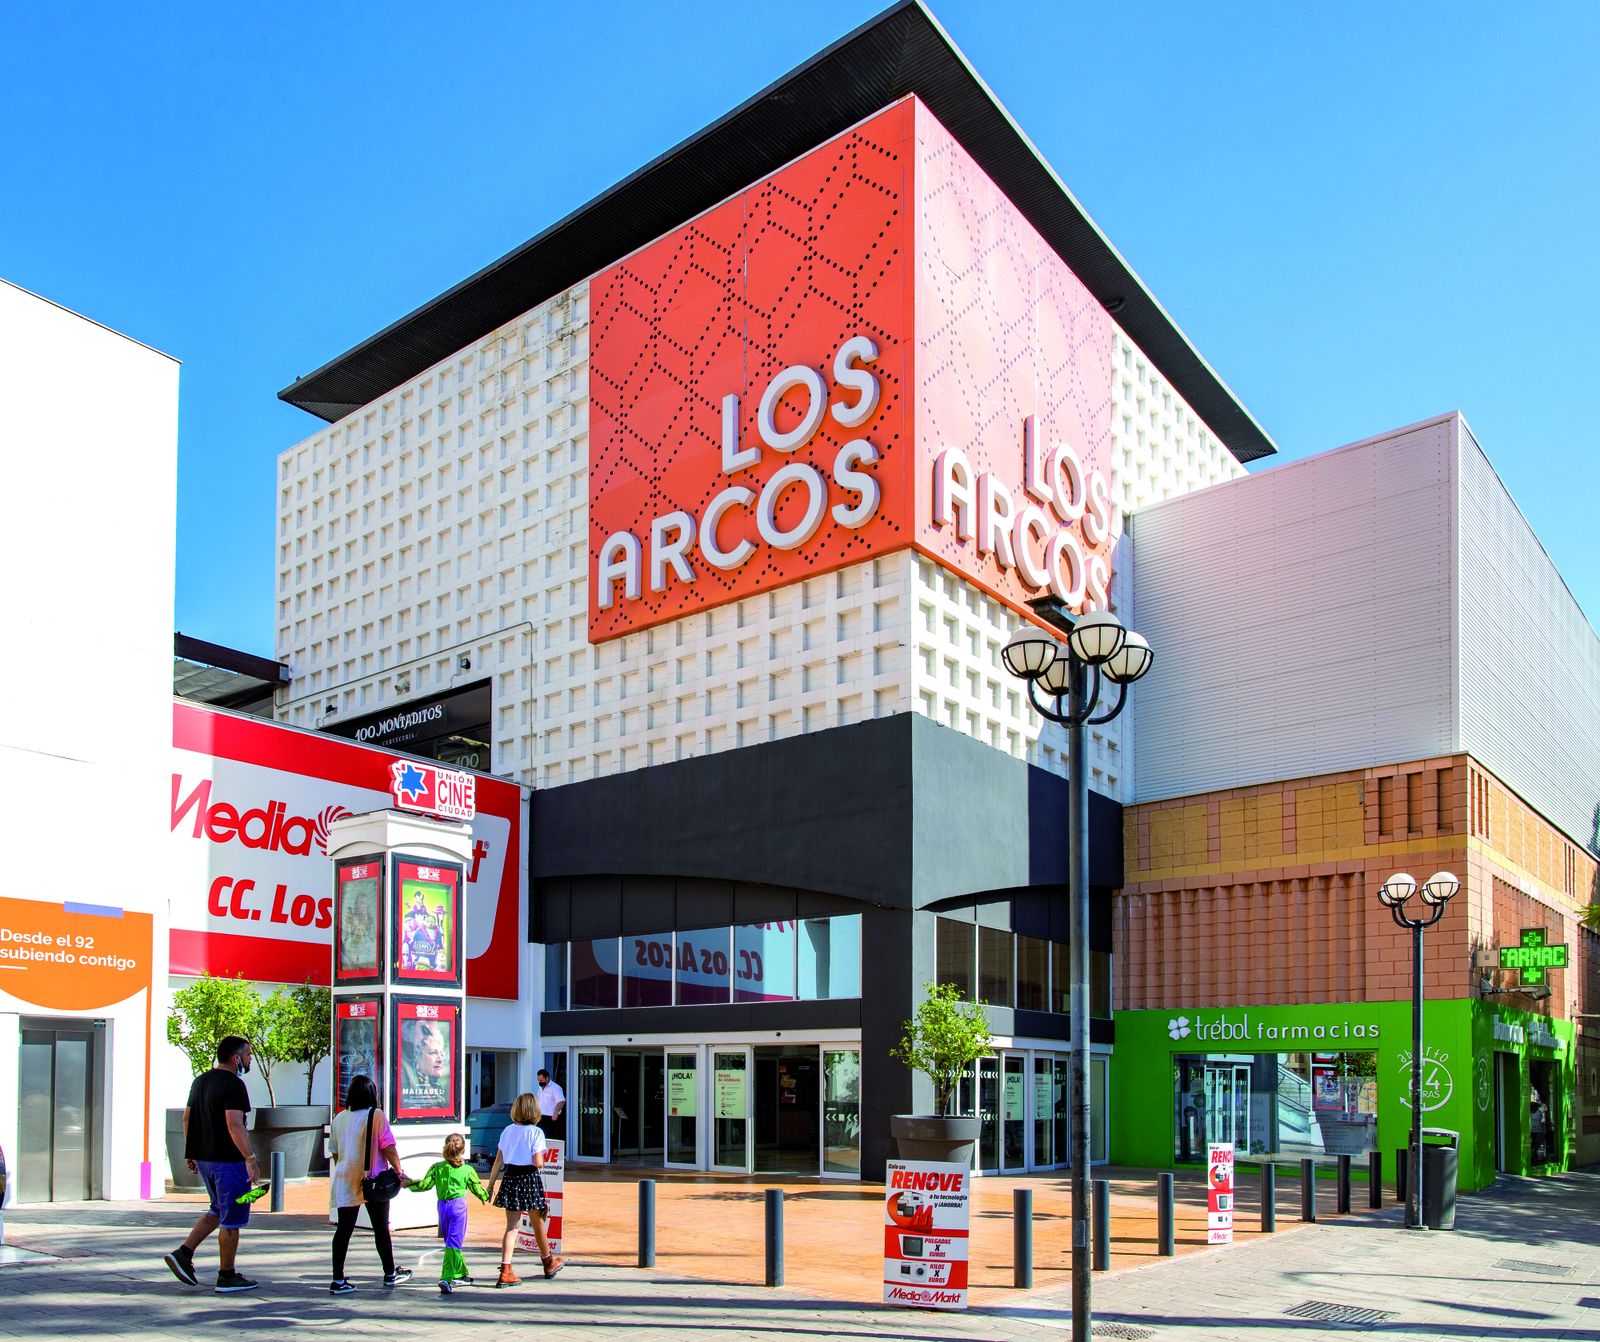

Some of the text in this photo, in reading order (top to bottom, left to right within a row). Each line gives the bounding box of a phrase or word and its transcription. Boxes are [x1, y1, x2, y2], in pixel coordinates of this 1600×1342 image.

[722, 335, 880, 475] LOS
[1024, 413, 1108, 545] LOS
[598, 438, 881, 610] ARCOS
[933, 446, 1108, 614] ARCOS
[355, 704, 443, 742] 100 MONTADITOS
[437, 771, 473, 785] UNIÓN
[437, 780, 473, 810] CINE
[437, 804, 473, 817] CIUDAD
[208, 875, 332, 929] CC. Los
[0, 928, 94, 949] Desde el 92
[0, 948, 136, 971] subiendo contigo
[1195, 1014, 1380, 1040] trébol farmacias
[1397, 1046, 1449, 1062] abrto
[891, 1171, 963, 1192] RENOVE
